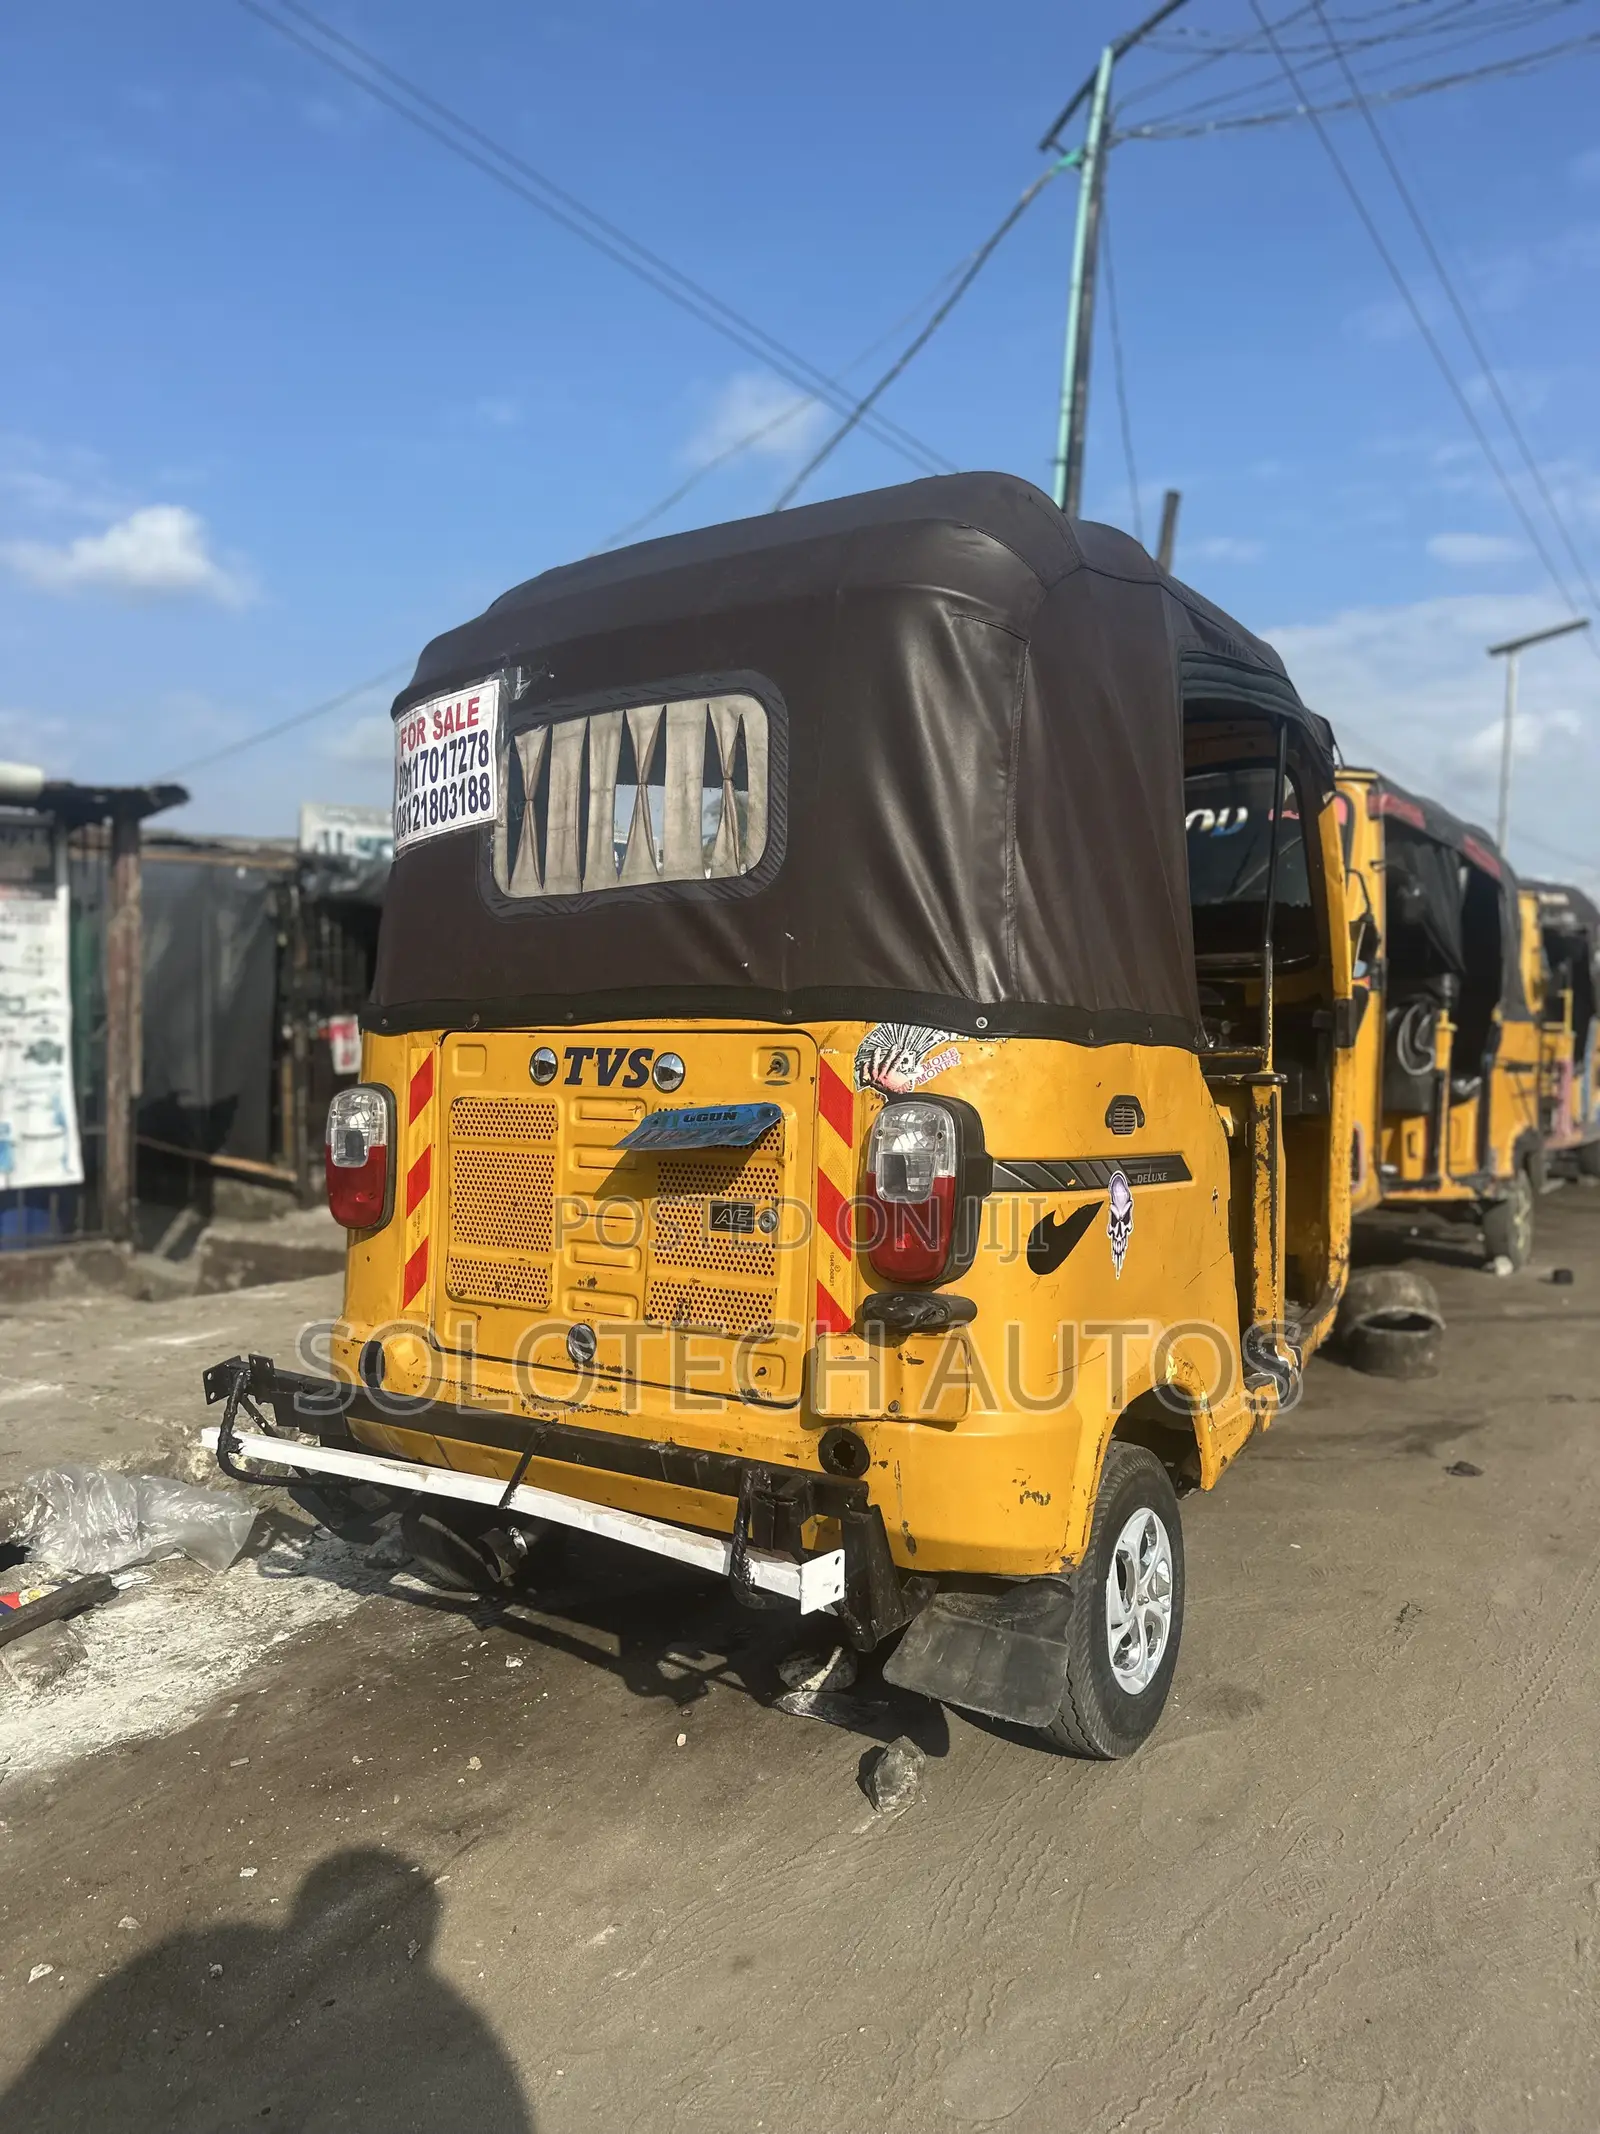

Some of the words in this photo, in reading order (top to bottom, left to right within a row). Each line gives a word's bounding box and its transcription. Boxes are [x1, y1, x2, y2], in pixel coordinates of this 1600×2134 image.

[400, 716, 426, 757] FOR
[432, 697, 480, 740] SALE
[399, 729, 489, 801] 09117017278
[396, 772, 491, 840] 08121803188
[563, 1048, 654, 1088] TVS
[916, 1056, 960, 1085] MONEY
[922, 1048, 957, 1072] MORE
[1136, 1172, 1168, 1184] DELUXE
